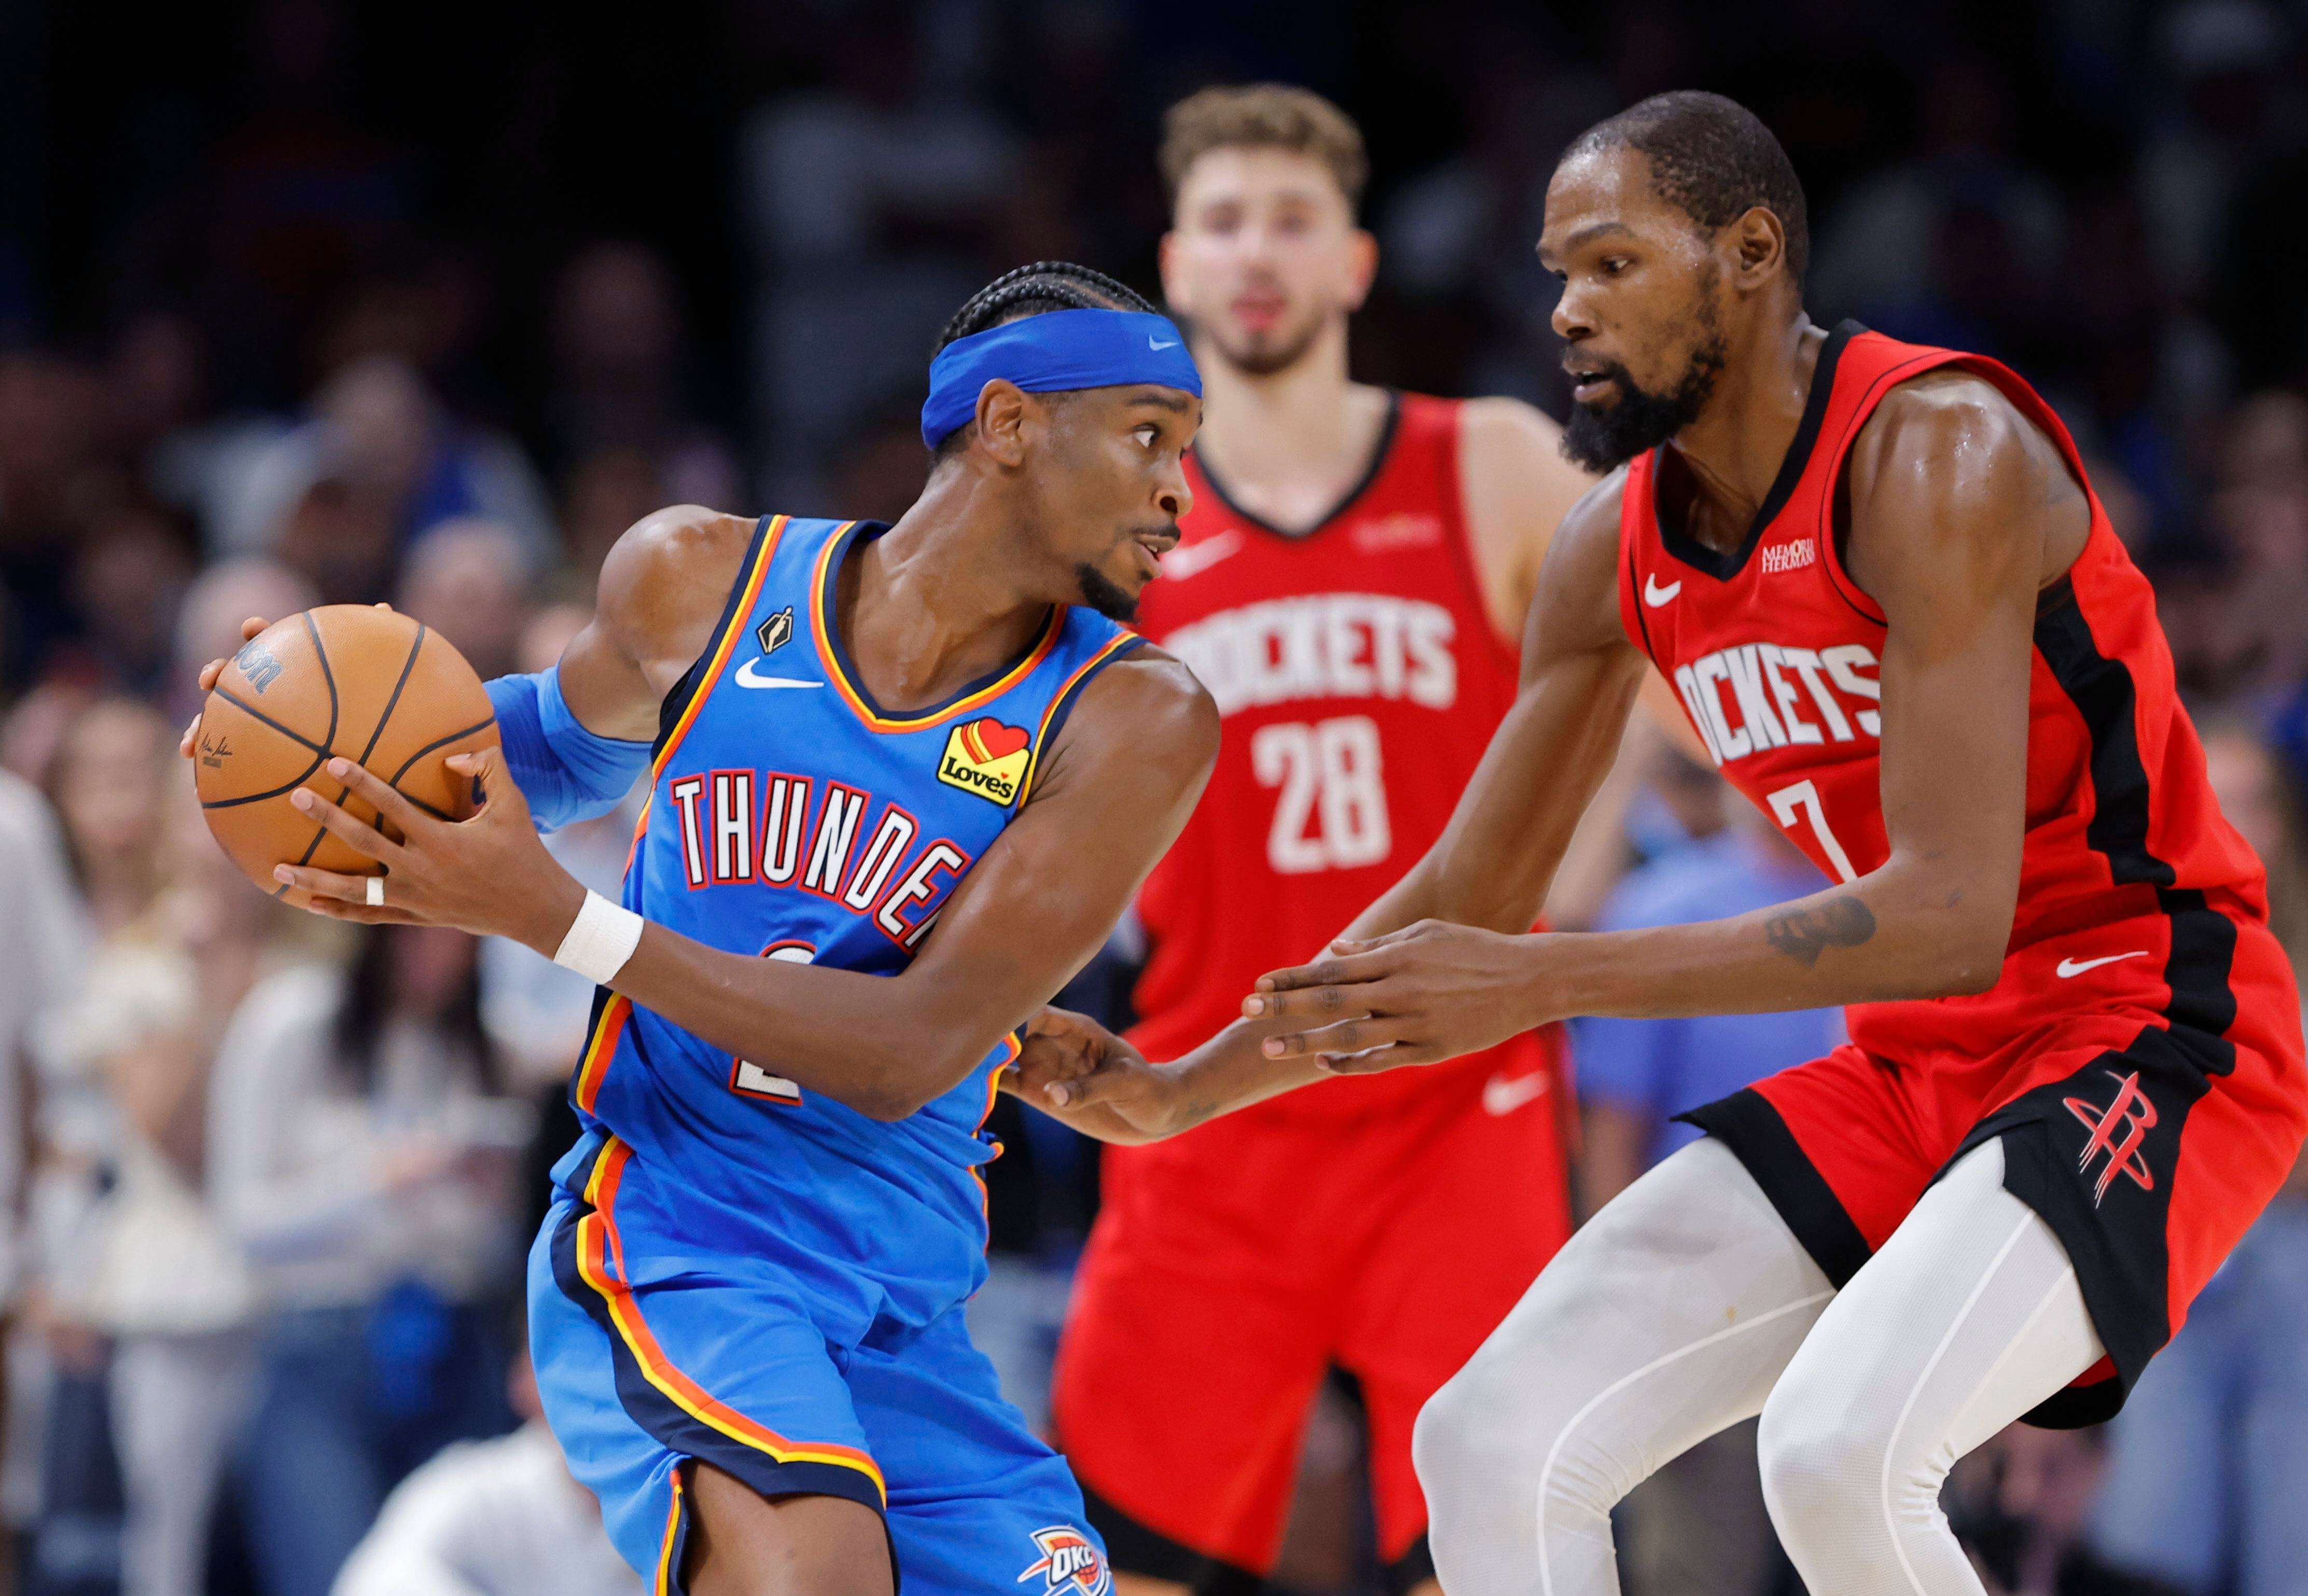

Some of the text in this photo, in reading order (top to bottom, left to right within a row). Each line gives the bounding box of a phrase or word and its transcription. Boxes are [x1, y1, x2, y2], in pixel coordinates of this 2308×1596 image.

[1250, 715, 1392, 874] 28
[1767, 779, 1858, 883] 7
[670, 769, 972, 955] THUNDE
[1051, 1545, 1095, 1584] OKC
